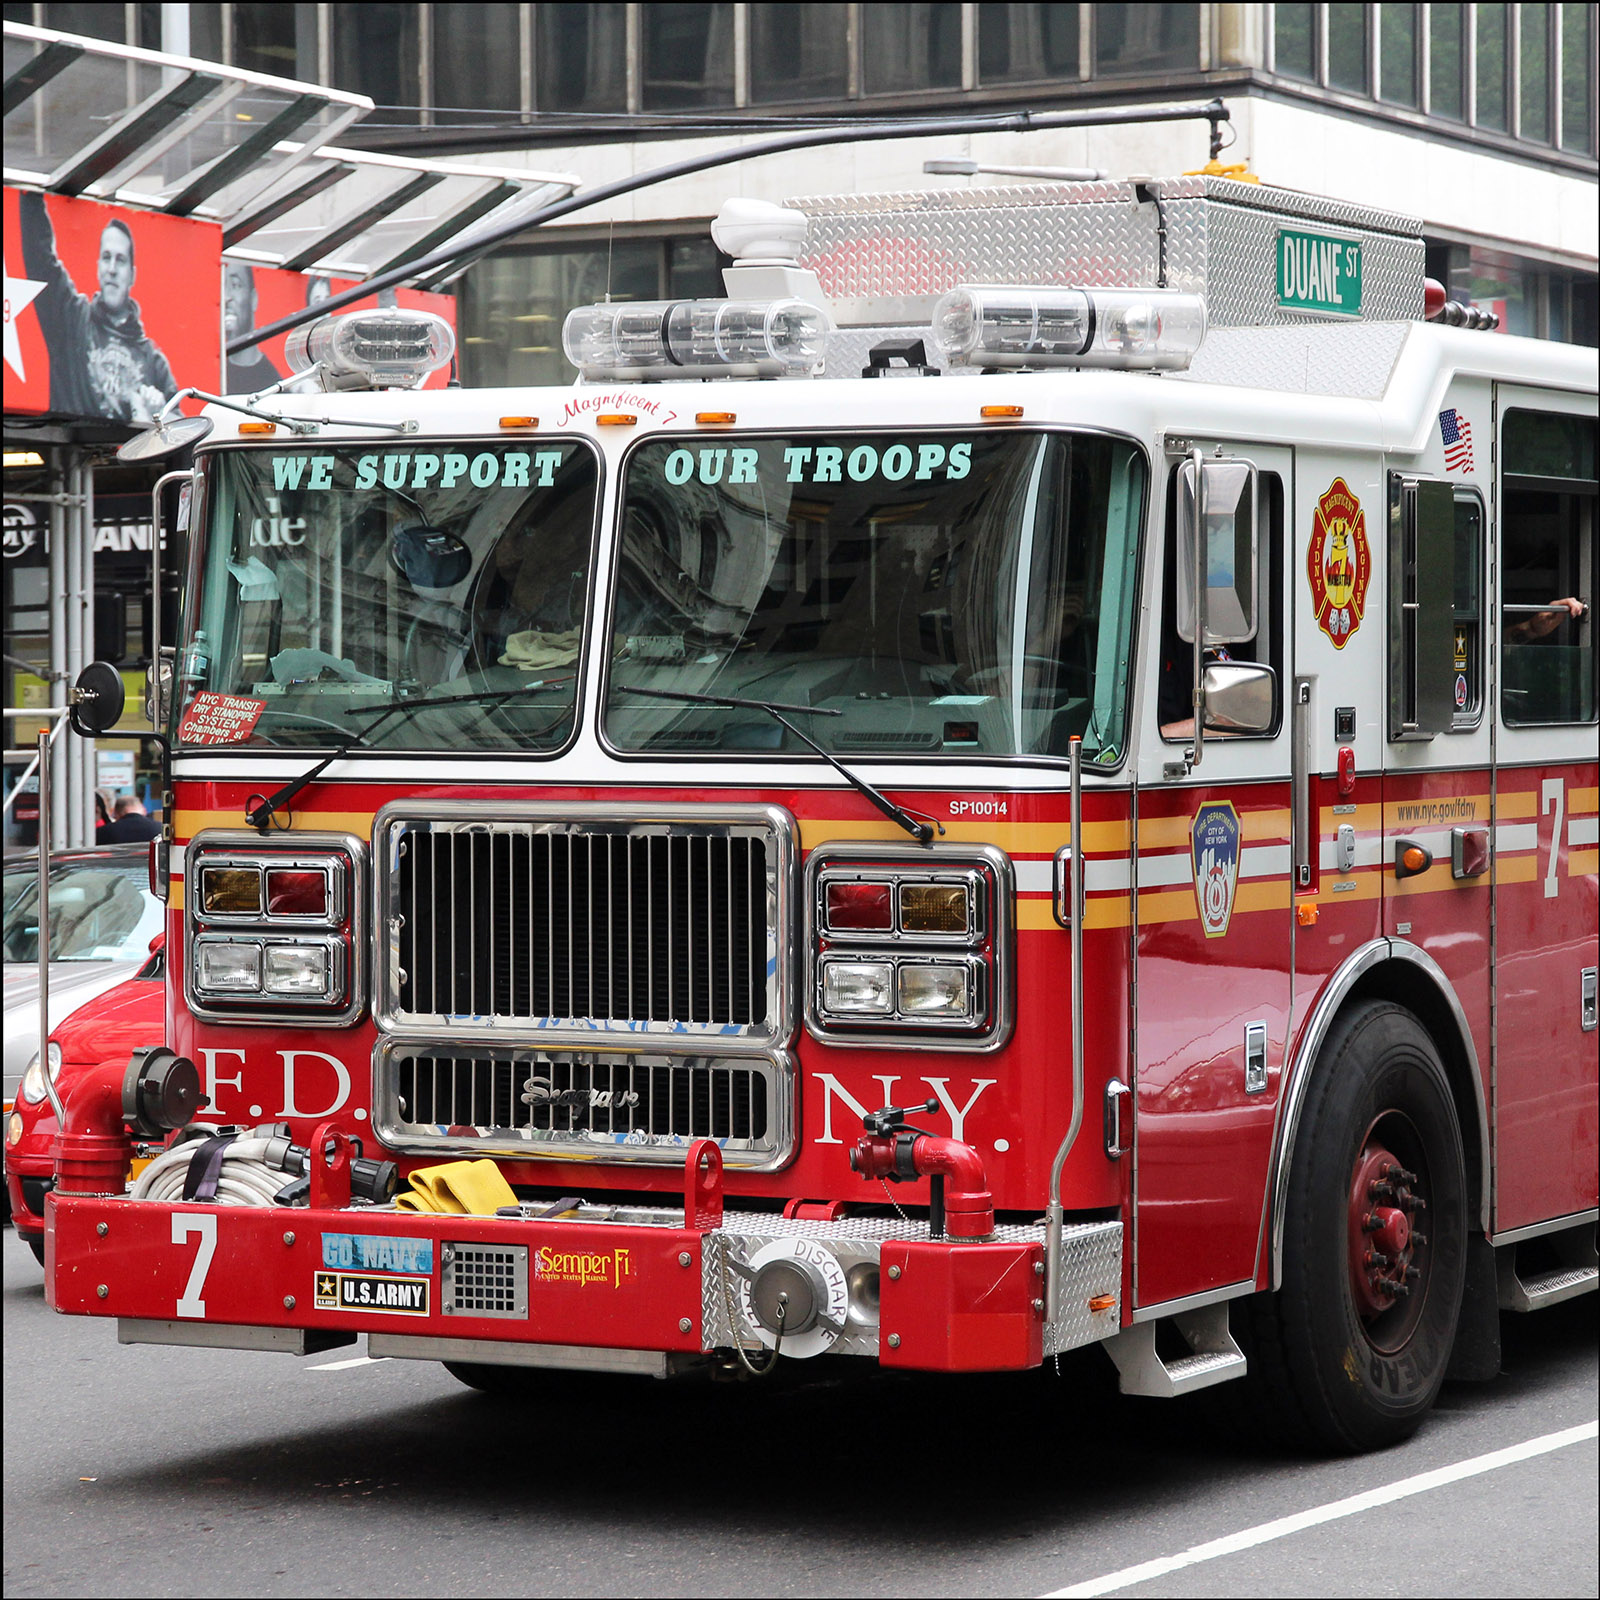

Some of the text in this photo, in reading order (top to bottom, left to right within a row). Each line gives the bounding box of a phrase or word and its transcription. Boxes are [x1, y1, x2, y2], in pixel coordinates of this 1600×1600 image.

[1284, 236, 1359, 304] DUANE ST
[557, 390, 677, 427] Magnificent 7
[271, 443, 972, 490] WE SUPPORT OUR TROOPS
[1314, 536, 1322, 592] FDNY
[1357, 527, 1366, 605] ENGINE
[192, 703, 256, 722] DRY STANDPIPE
[199, 693, 261, 712] NYC TRANSIT
[184, 722, 231, 738] Chambers
[197, 714, 241, 730] SYSTEM
[949, 801, 1008, 815] SP10014
[1397, 798, 1477, 823] www.nyc.gov/fdny
[1542, 778, 1564, 898] 7
[171, 1212, 217, 1318] 7
[323, 1236, 353, 1267] GO
[539, 1246, 630, 1289] Semper Fi
